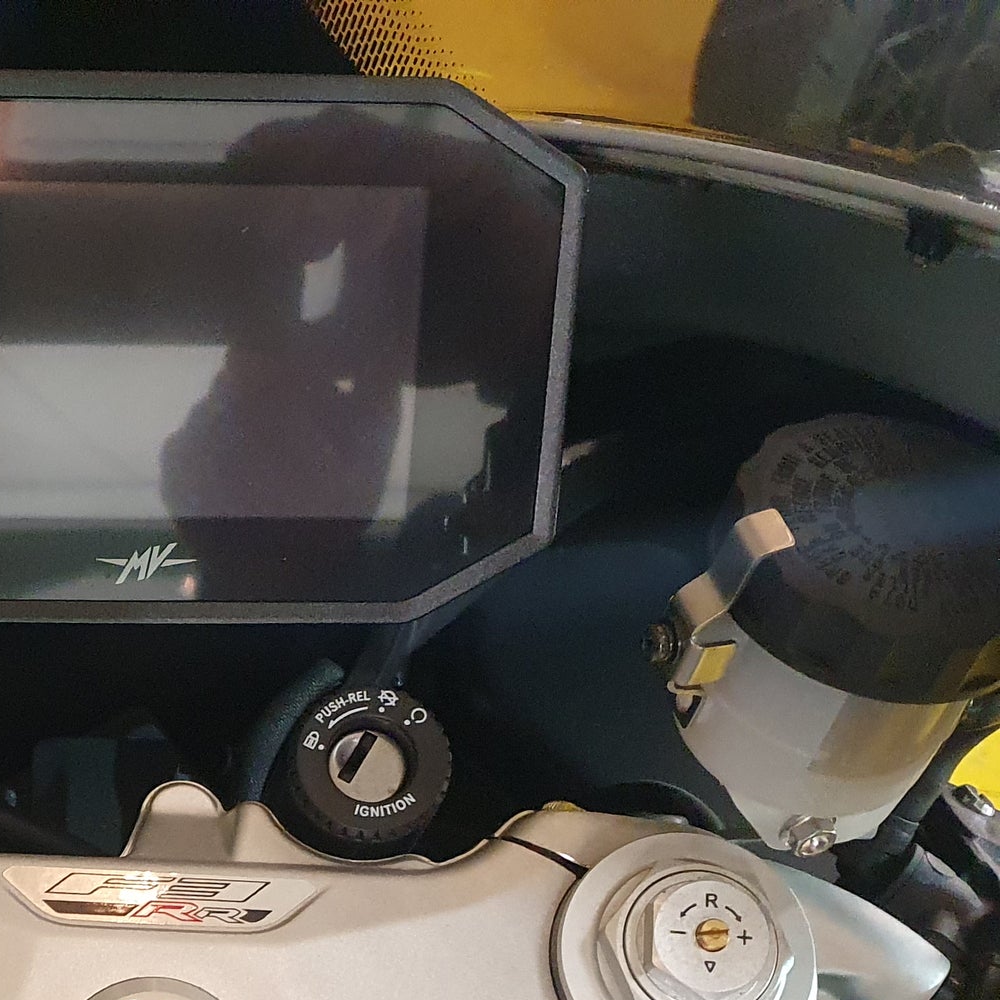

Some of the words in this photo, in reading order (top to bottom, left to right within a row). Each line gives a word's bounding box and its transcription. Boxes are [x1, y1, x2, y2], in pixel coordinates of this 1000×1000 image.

[115, 542, 178, 585] MV
[314, 690, 371, 724] PUSH-REL
[354, 793, 417, 817] IGNITION
[131, 900, 245, 924] RR
[705, 893, 718, 908] R
